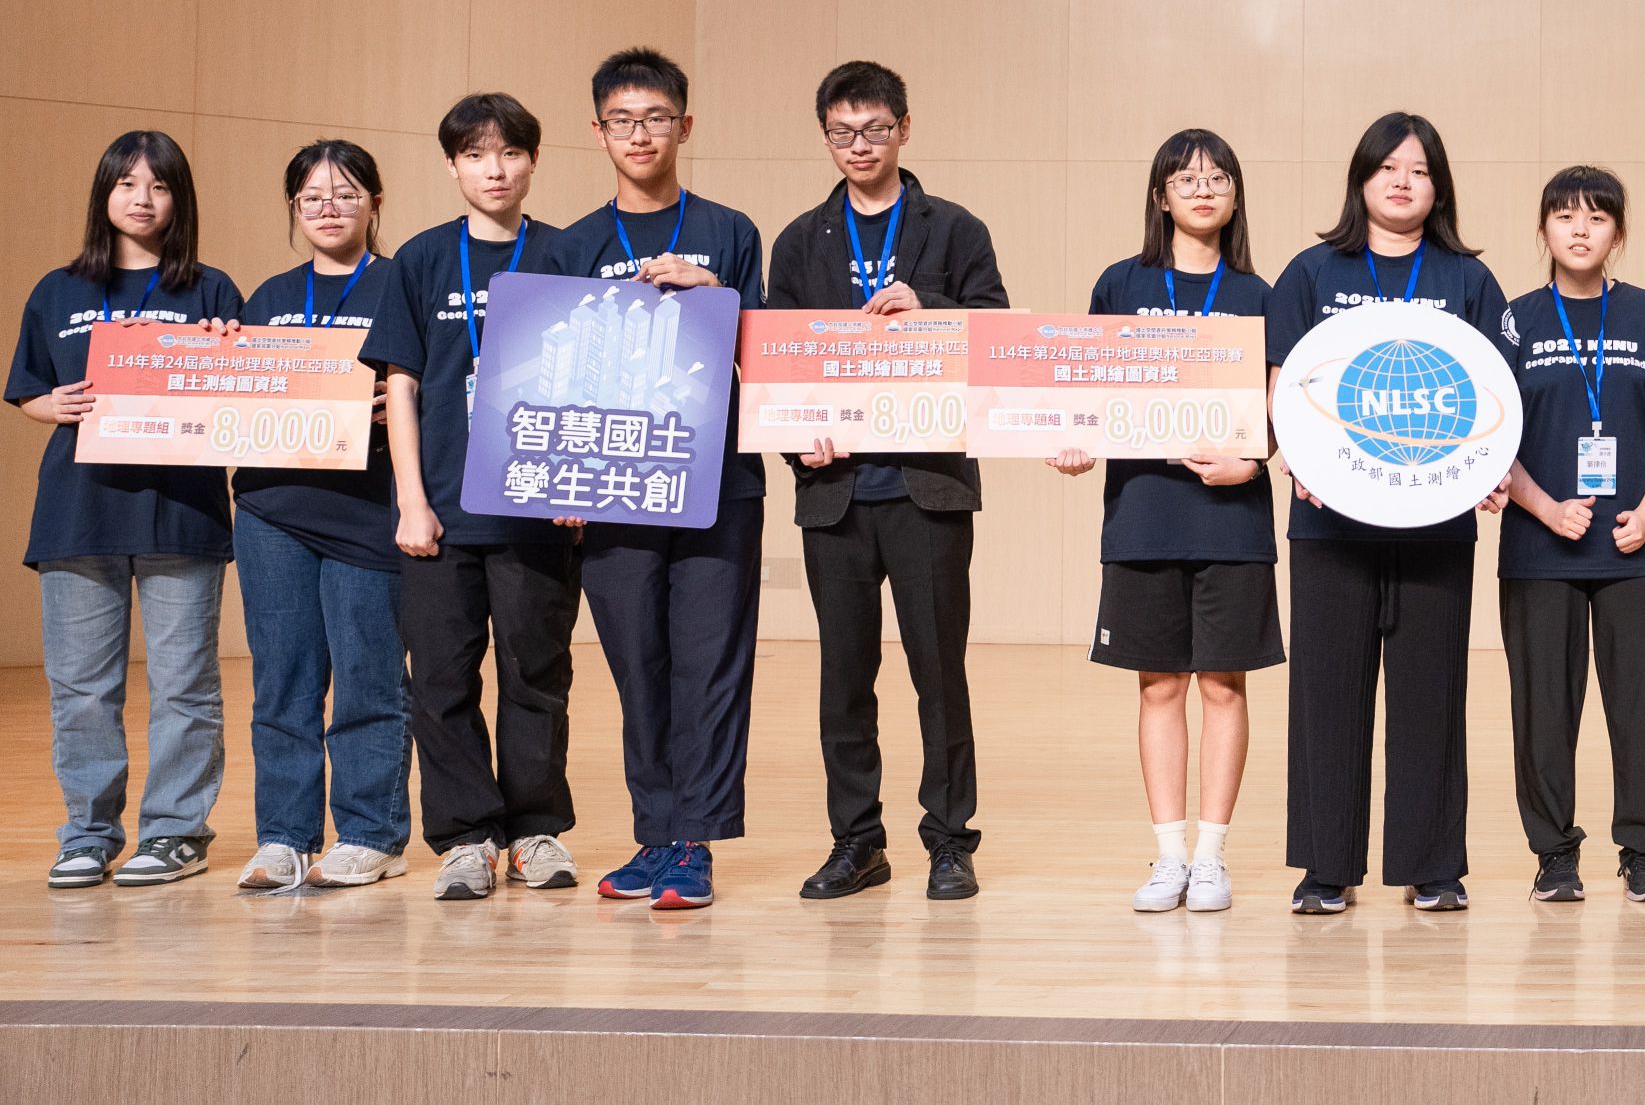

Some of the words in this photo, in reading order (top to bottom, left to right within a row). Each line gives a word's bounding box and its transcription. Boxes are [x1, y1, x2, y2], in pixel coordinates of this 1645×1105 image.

[988, 345, 1243, 363] 114年第24屆高中地理奧林匹亞競賽
[1532, 338, 1582, 355] 2025
[107, 354, 354, 374] 114年第24屆高中地理奧林匹亞競賽
[823, 360, 943, 377] 國土測繪圖資獎
[1054, 365, 1178, 383] 國土測繪圖資獎
[167, 373, 289, 393] 國土測繪圖資獎
[1362, 387, 1456, 415] NLSC
[840, 409, 864, 421] 獎金
[1073, 414, 1099, 426] 獎金
[1105, 398, 1231, 449] 8,000
[1235, 429, 1247, 440] 元
[181, 422, 205, 435] 獎金
[212, 407, 335, 458] 8,000
[336, 441, 347, 452] 元
[512, 407, 691, 459] 智慧國土
[1338, 446, 1489, 487] 內政部國土測繪中心
[504, 459, 687, 514] 孿生共創
